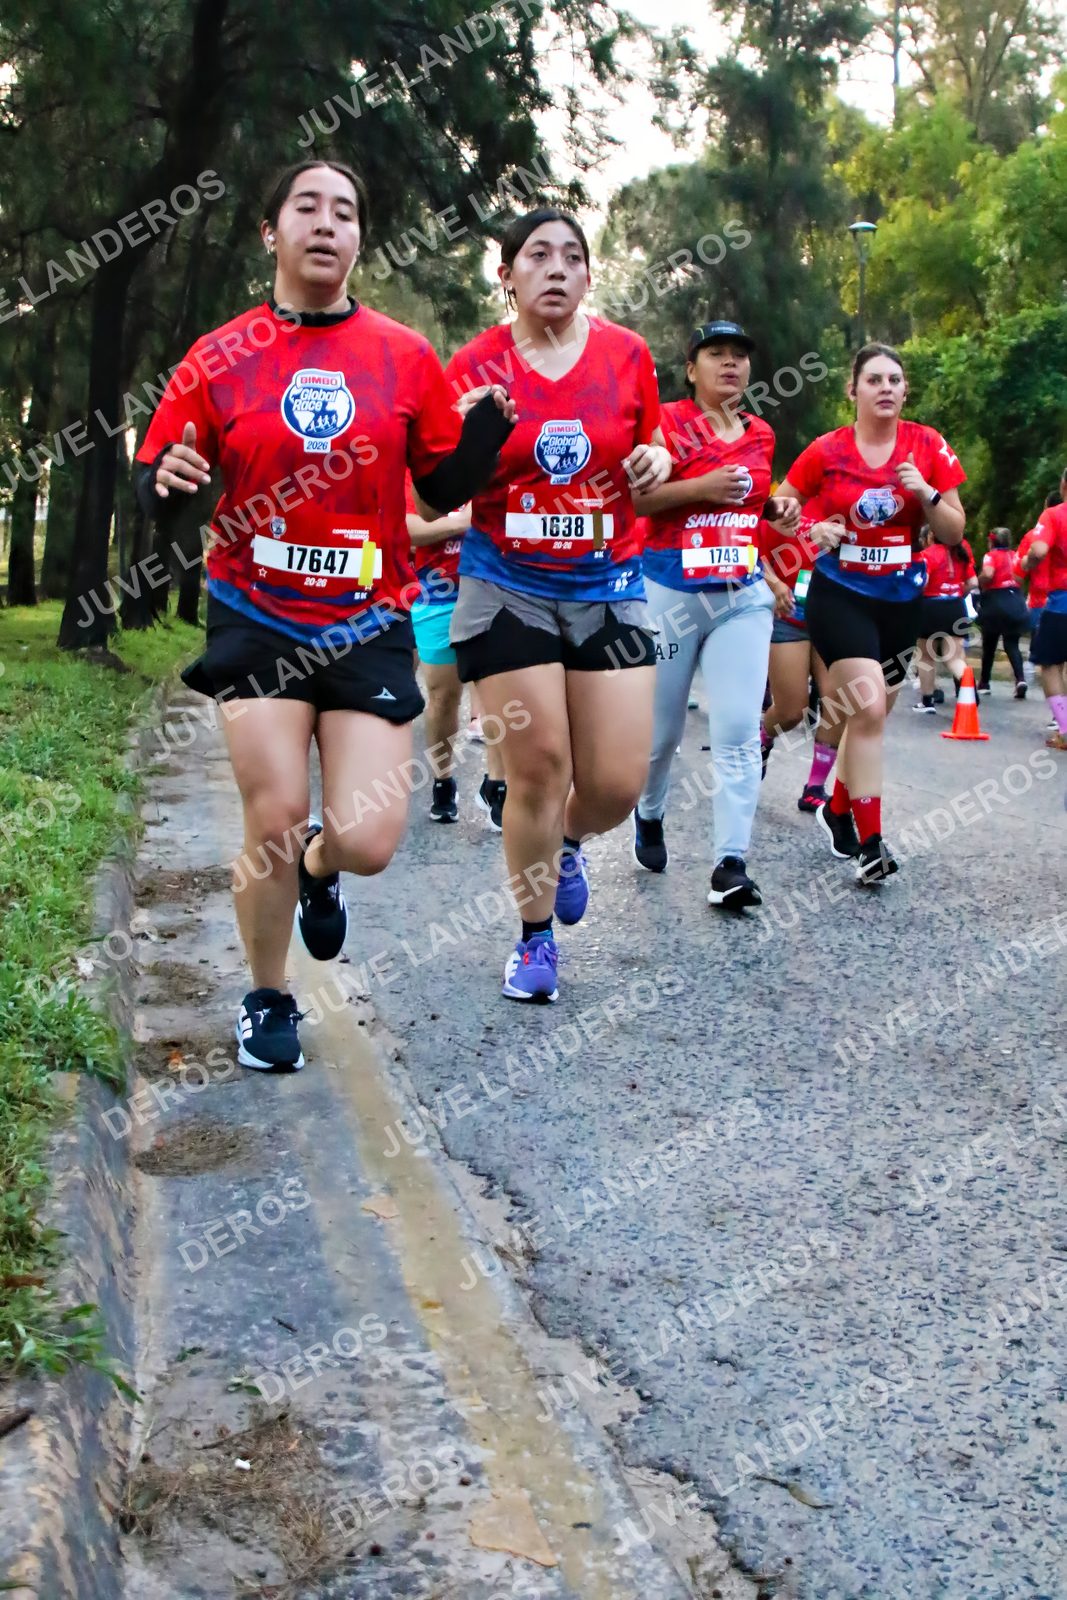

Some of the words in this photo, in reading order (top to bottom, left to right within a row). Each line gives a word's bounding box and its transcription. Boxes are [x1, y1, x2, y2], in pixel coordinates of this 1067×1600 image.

[300, 376, 338, 386] BIMBO
[300, 389, 337, 402] Global
[293, 399, 322, 412] Race
[306, 441, 328, 450] 2026
[549, 436, 577, 447] Global
[543, 445, 567, 456] Race
[685, 512, 759, 529] SANTIAGO
[286, 545, 349, 575] 17647
[709, 548, 739, 564] 1743
[860, 548, 889, 562] 3417
[304, 577, 328, 588] 20-26
